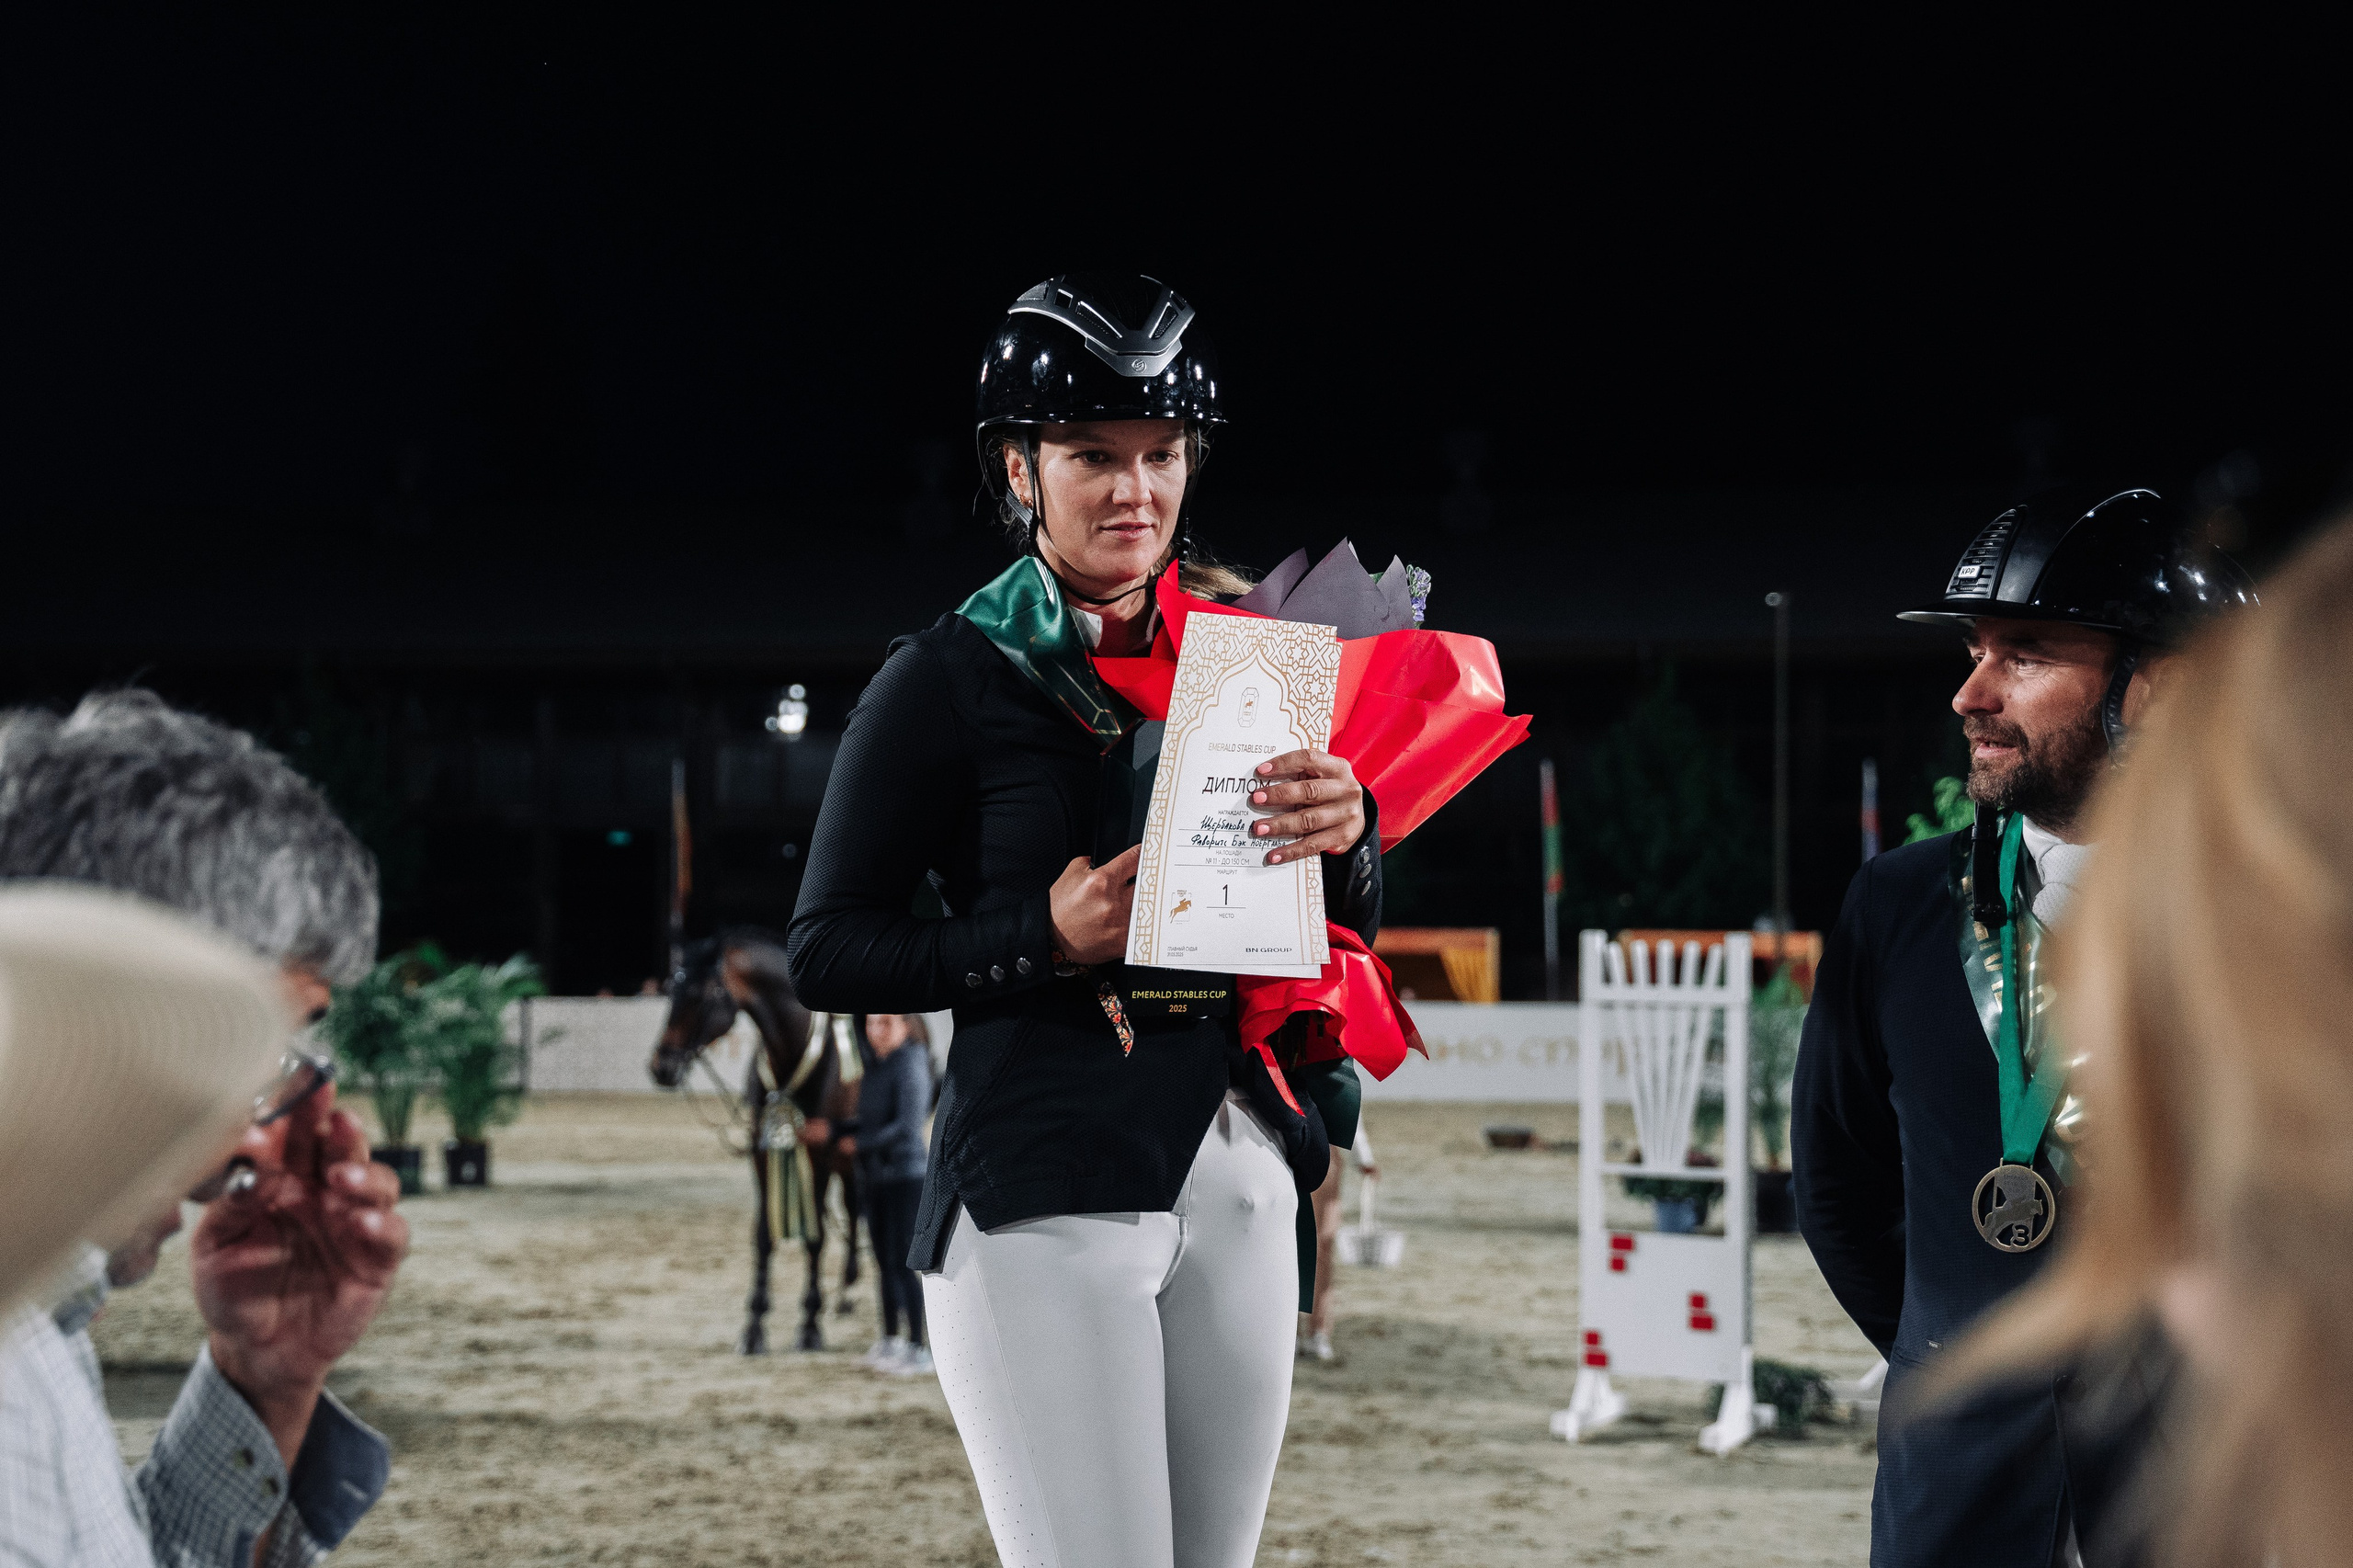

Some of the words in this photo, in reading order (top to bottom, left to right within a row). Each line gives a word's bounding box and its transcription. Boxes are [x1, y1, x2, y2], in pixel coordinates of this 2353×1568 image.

[1208, 742, 1236, 753] EMERALD
[1236, 744, 1263, 754] STABLES
[1263, 745, 1277, 755] CUP
[1222, 884, 1228, 905] 1
[1131, 990, 1172, 1000] EMERALD
[1173, 990, 1208, 1000] STABLES
[1209, 990, 1227, 1000] CUP
[1168, 1004, 1188, 1013] 2025
[2013, 1224, 2029, 1244] 3
